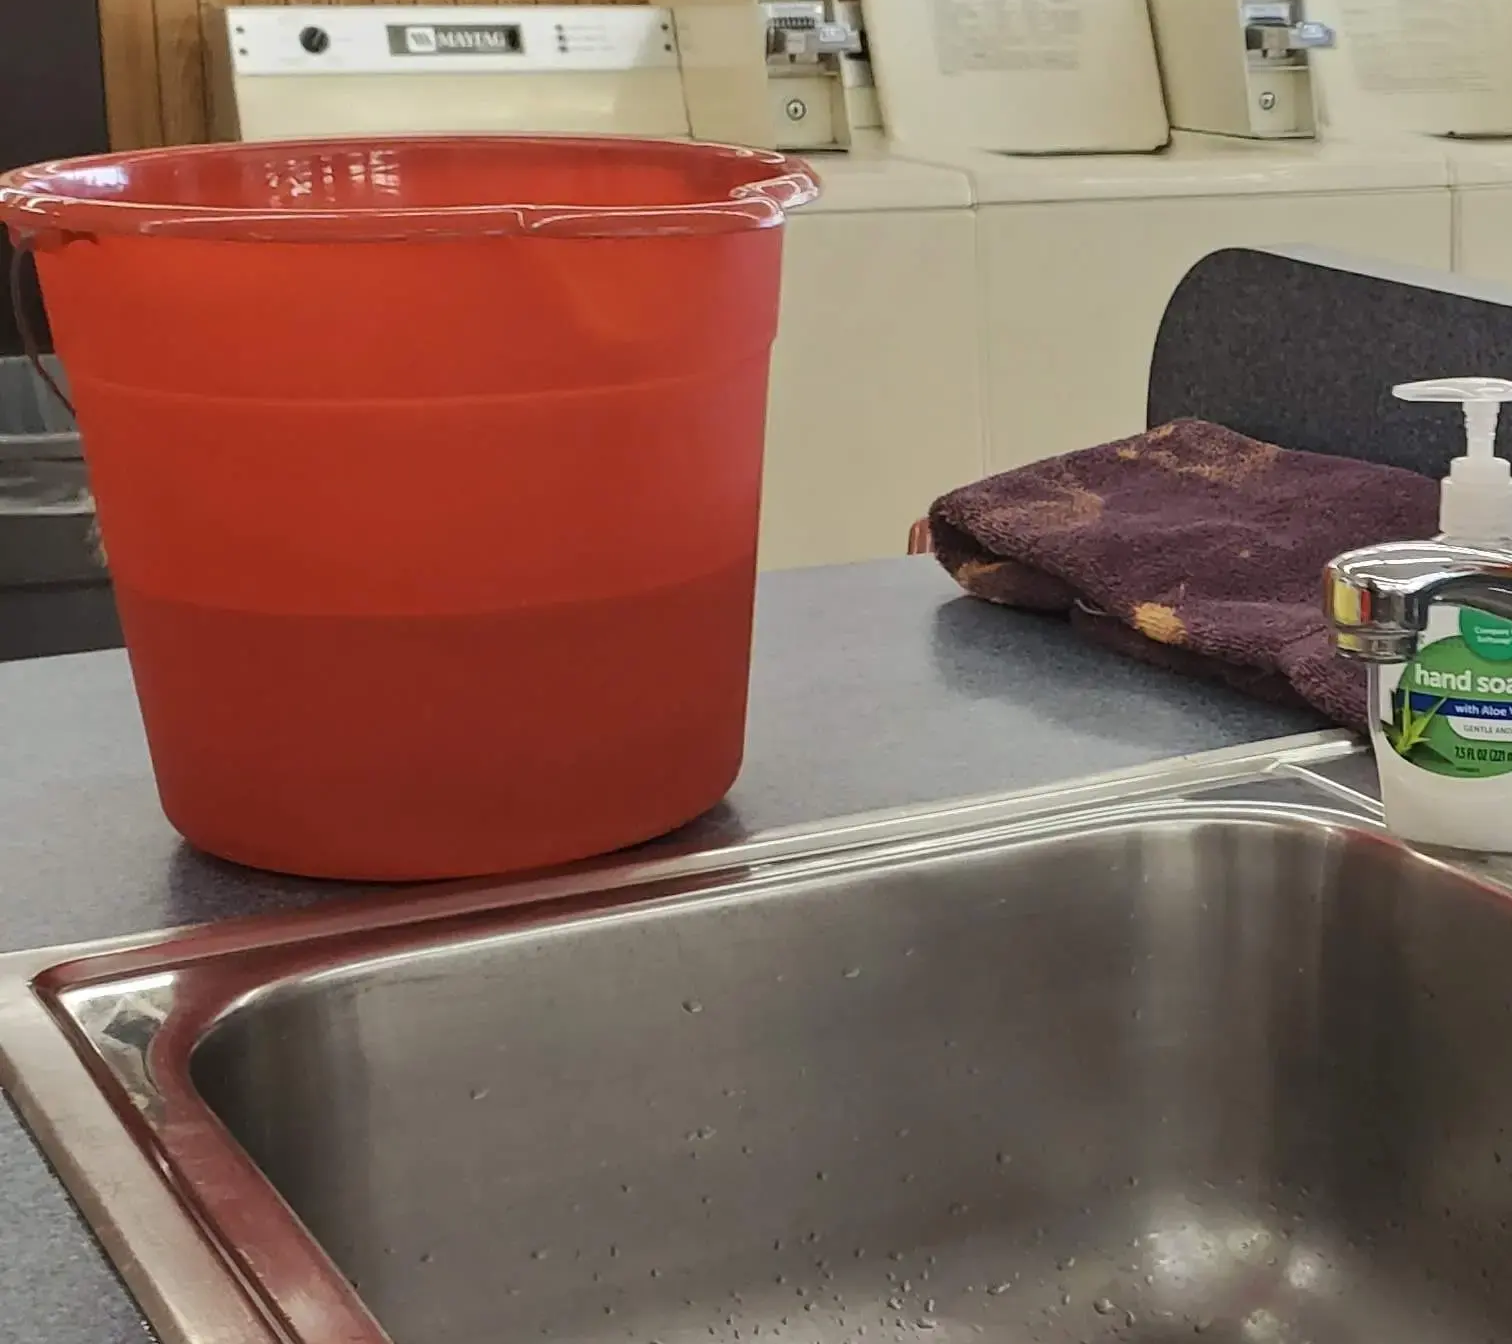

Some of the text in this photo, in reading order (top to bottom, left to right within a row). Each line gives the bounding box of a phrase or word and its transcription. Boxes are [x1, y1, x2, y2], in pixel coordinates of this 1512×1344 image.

[1414, 663, 1472, 692] hand
[1455, 704, 1479, 716] with
[1481, 705, 1507, 717] Aloe
[1463, 724, 1493, 734] GENTLE
[1495, 726, 1512, 735] AND
